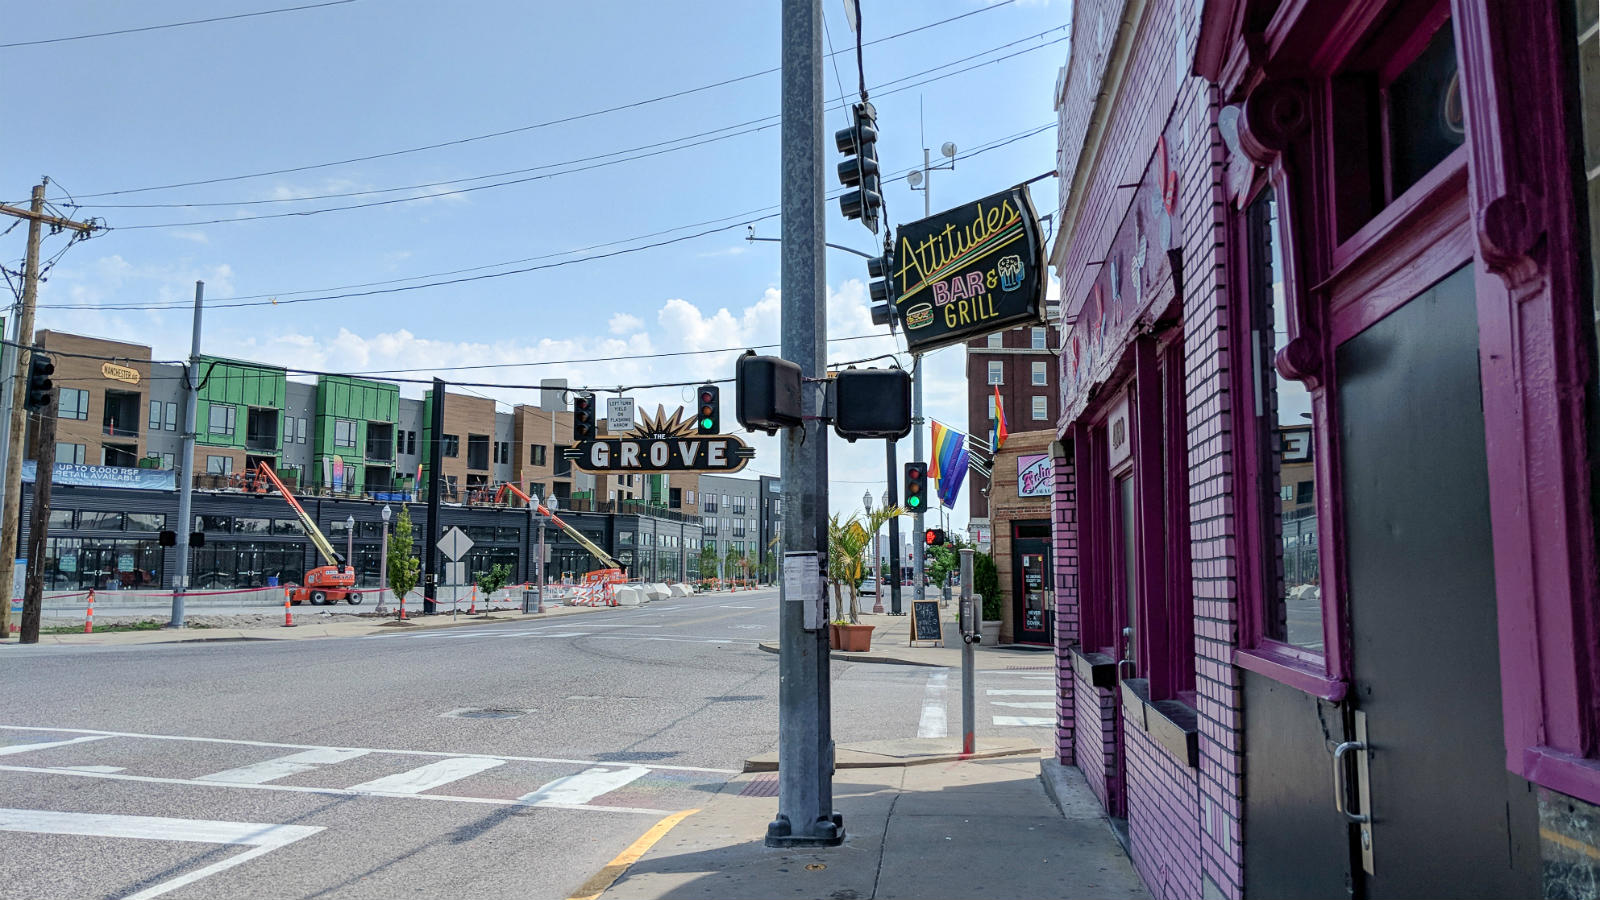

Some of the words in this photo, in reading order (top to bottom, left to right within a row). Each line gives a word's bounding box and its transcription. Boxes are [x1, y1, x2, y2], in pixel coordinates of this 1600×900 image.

[894, 199, 1020, 294] Attitudes
[932, 271, 986, 307] BAR
[986, 268, 998, 289] &
[944, 293, 999, 328] GRILL
[104, 365, 131, 379] MANCHESTER
[590, 441, 728, 468] GROVE
[56, 470, 86, 479] RETAIL
[91, 472, 141, 482] AVAILABLE
[90, 466, 119, 475] 6,000
[120, 468, 139, 476] RSF
